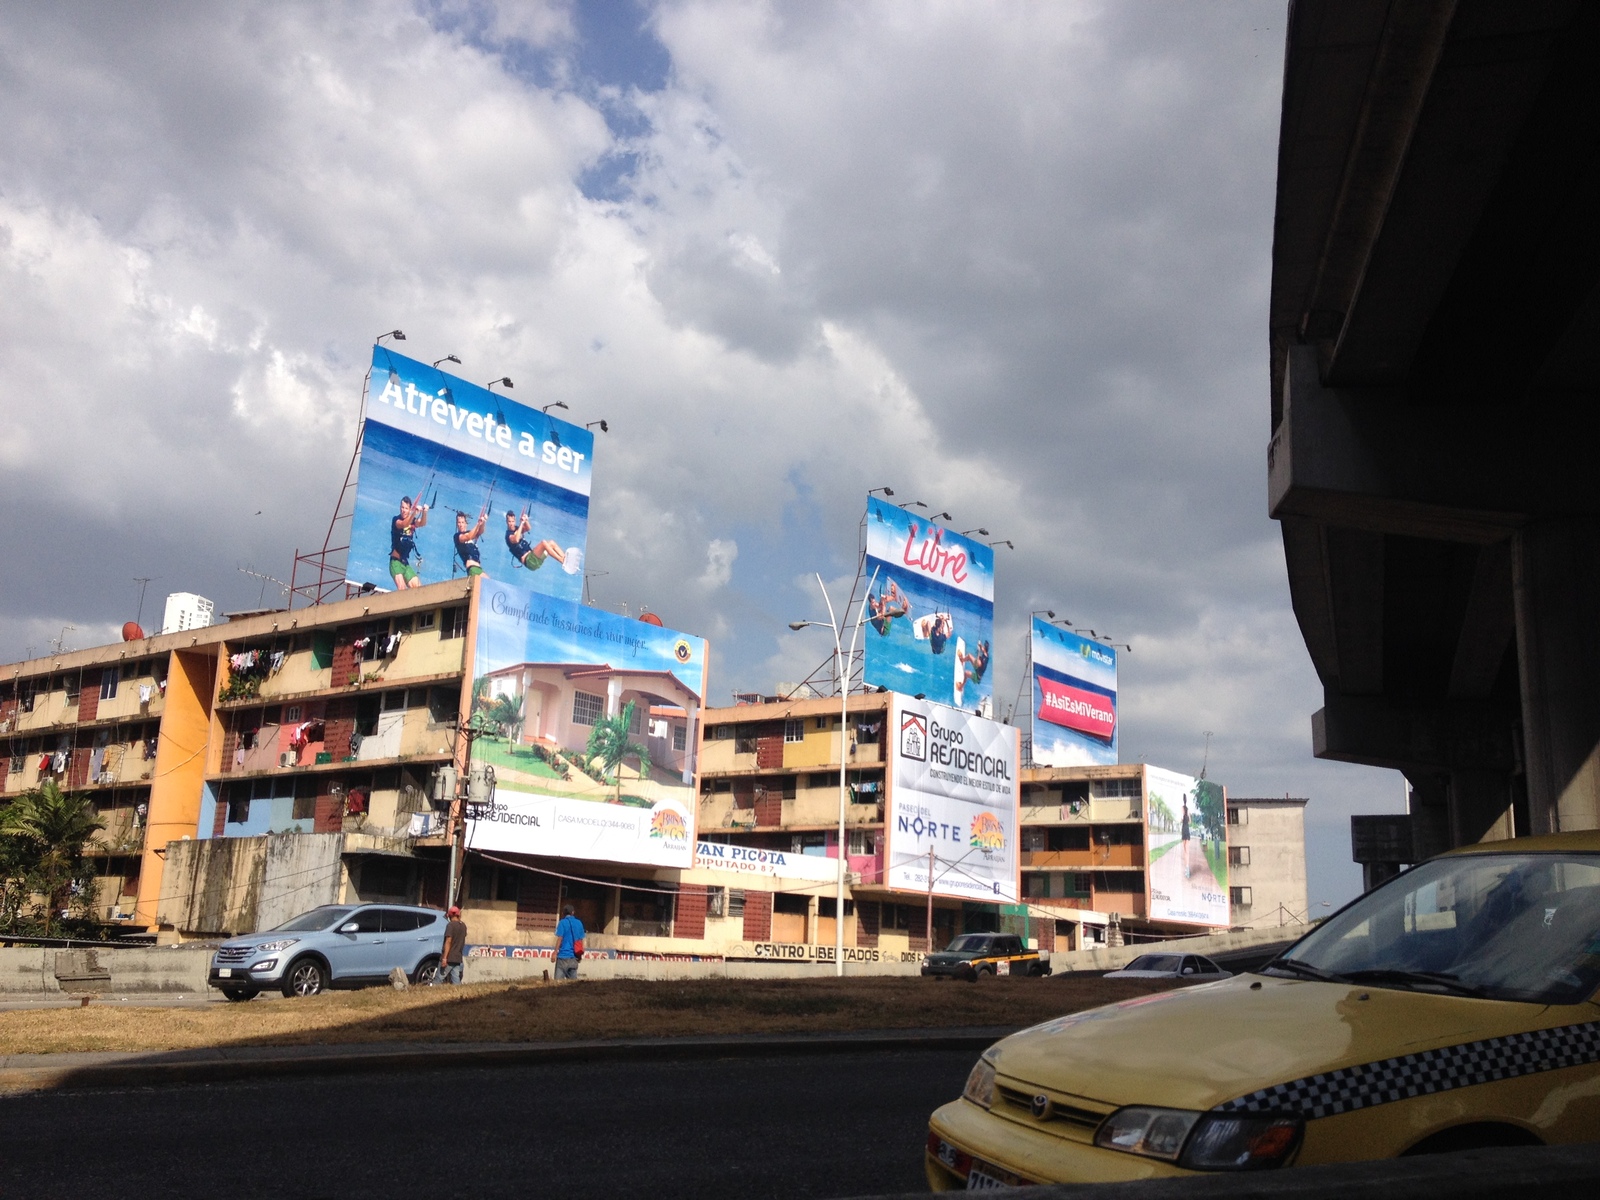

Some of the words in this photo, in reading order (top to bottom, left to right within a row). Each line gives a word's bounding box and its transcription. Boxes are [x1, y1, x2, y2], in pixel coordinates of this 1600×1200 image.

[378, 378, 512, 449] Atrévete
[518, 431, 536, 459] a
[541, 441, 585, 475] ser
[903, 524, 967, 583] Libre
[491, 591, 550, 626] Cumpliendo
[930, 720, 964, 745] Grupo
[929, 742, 1011, 781] RESIDENCIAL
[557, 815, 576, 824] CASA
[920, 807, 931, 817] DEL
[898, 815, 961, 842] NORTE
[731, 847, 787, 866] PICOTA
[754, 943, 805, 959] CENTRO
[808, 946, 880, 962] LIBETADOS
[901, 951, 916, 963] DIOS
